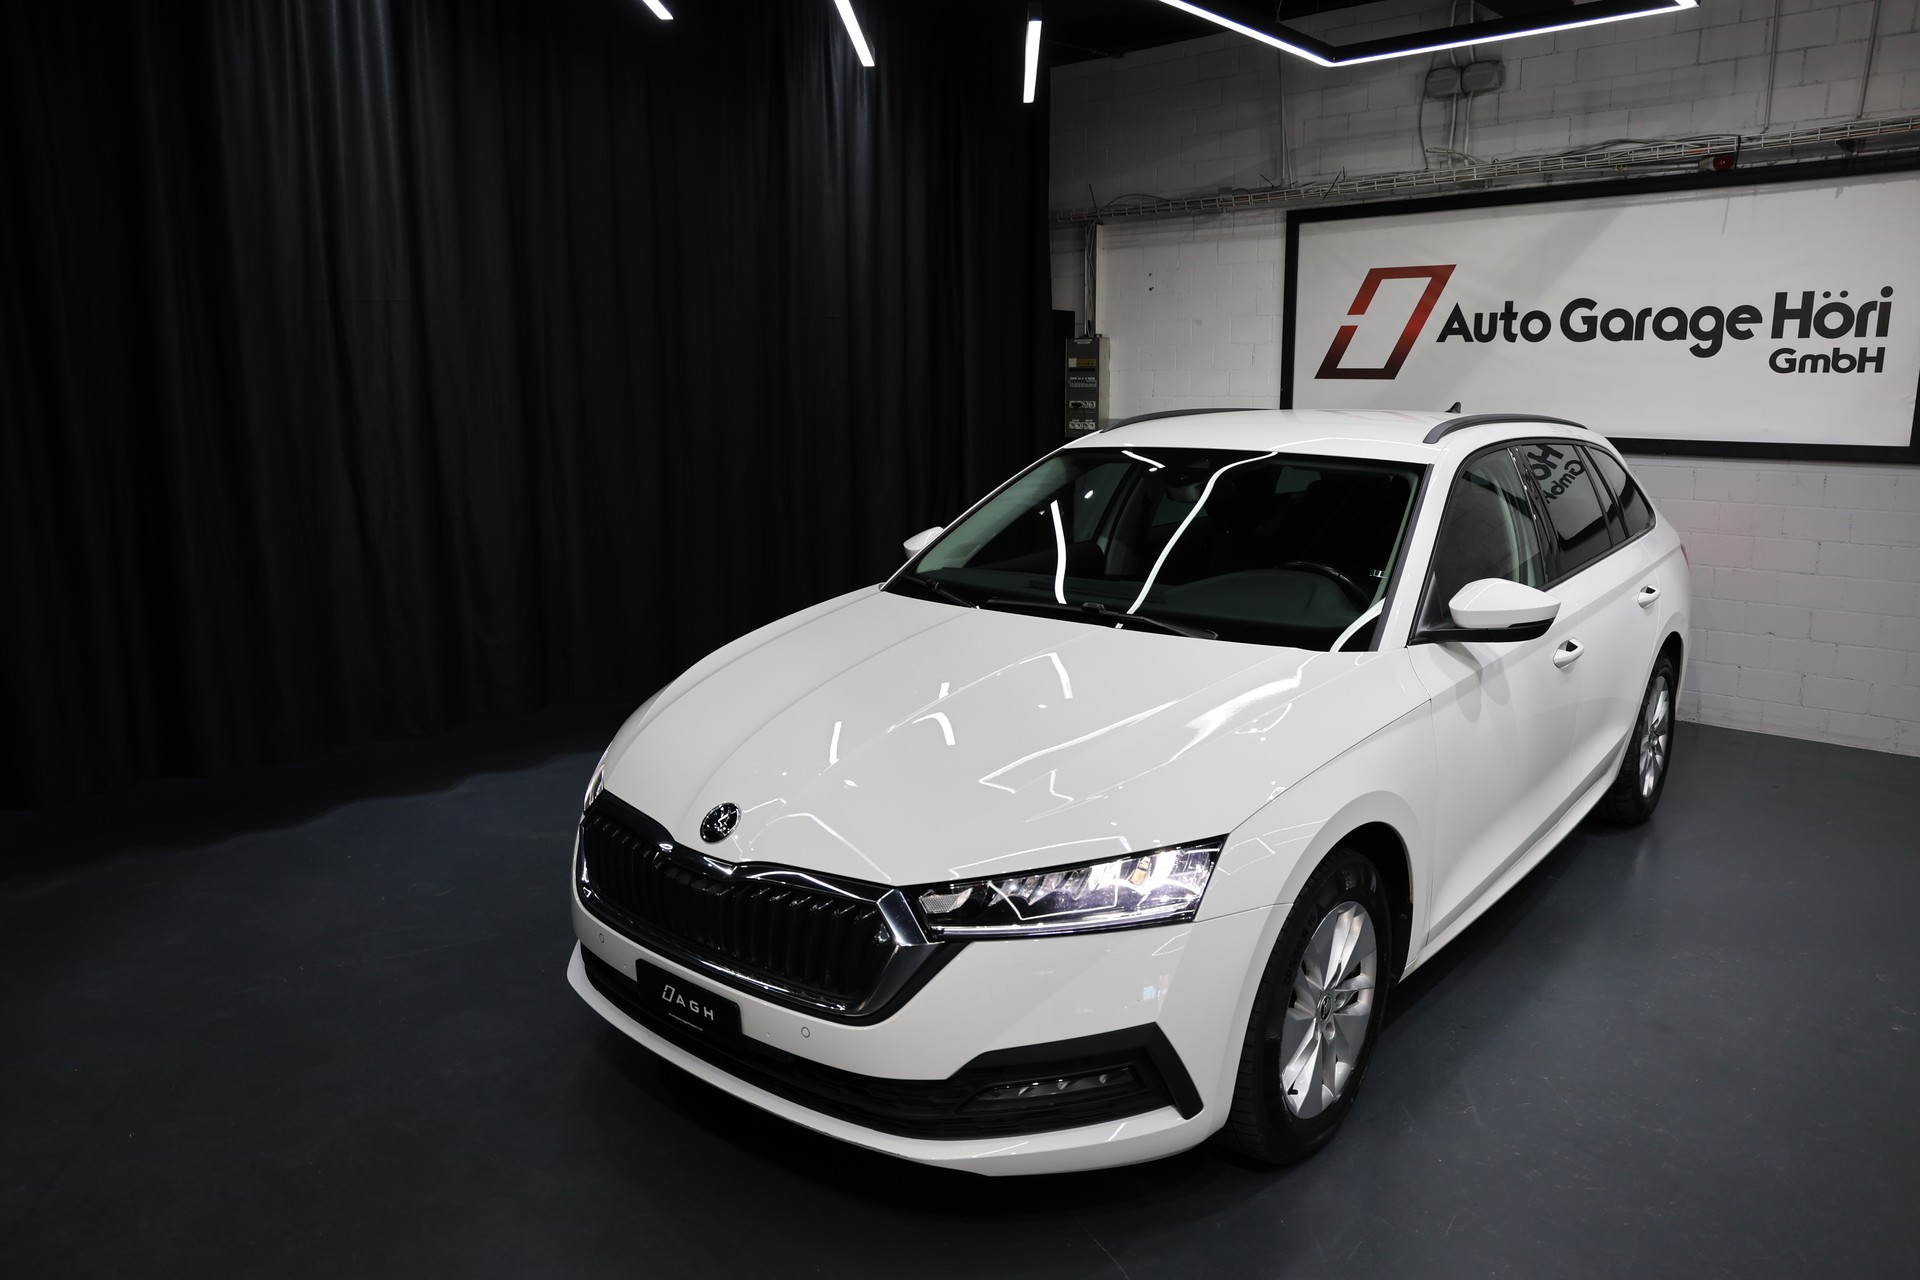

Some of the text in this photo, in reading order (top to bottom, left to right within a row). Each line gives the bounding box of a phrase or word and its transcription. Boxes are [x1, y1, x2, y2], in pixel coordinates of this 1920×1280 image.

[1436, 286, 1894, 359] Auto Garage Höri
[1769, 347, 1886, 374] GmbH
[676, 994, 714, 1021] AGH
